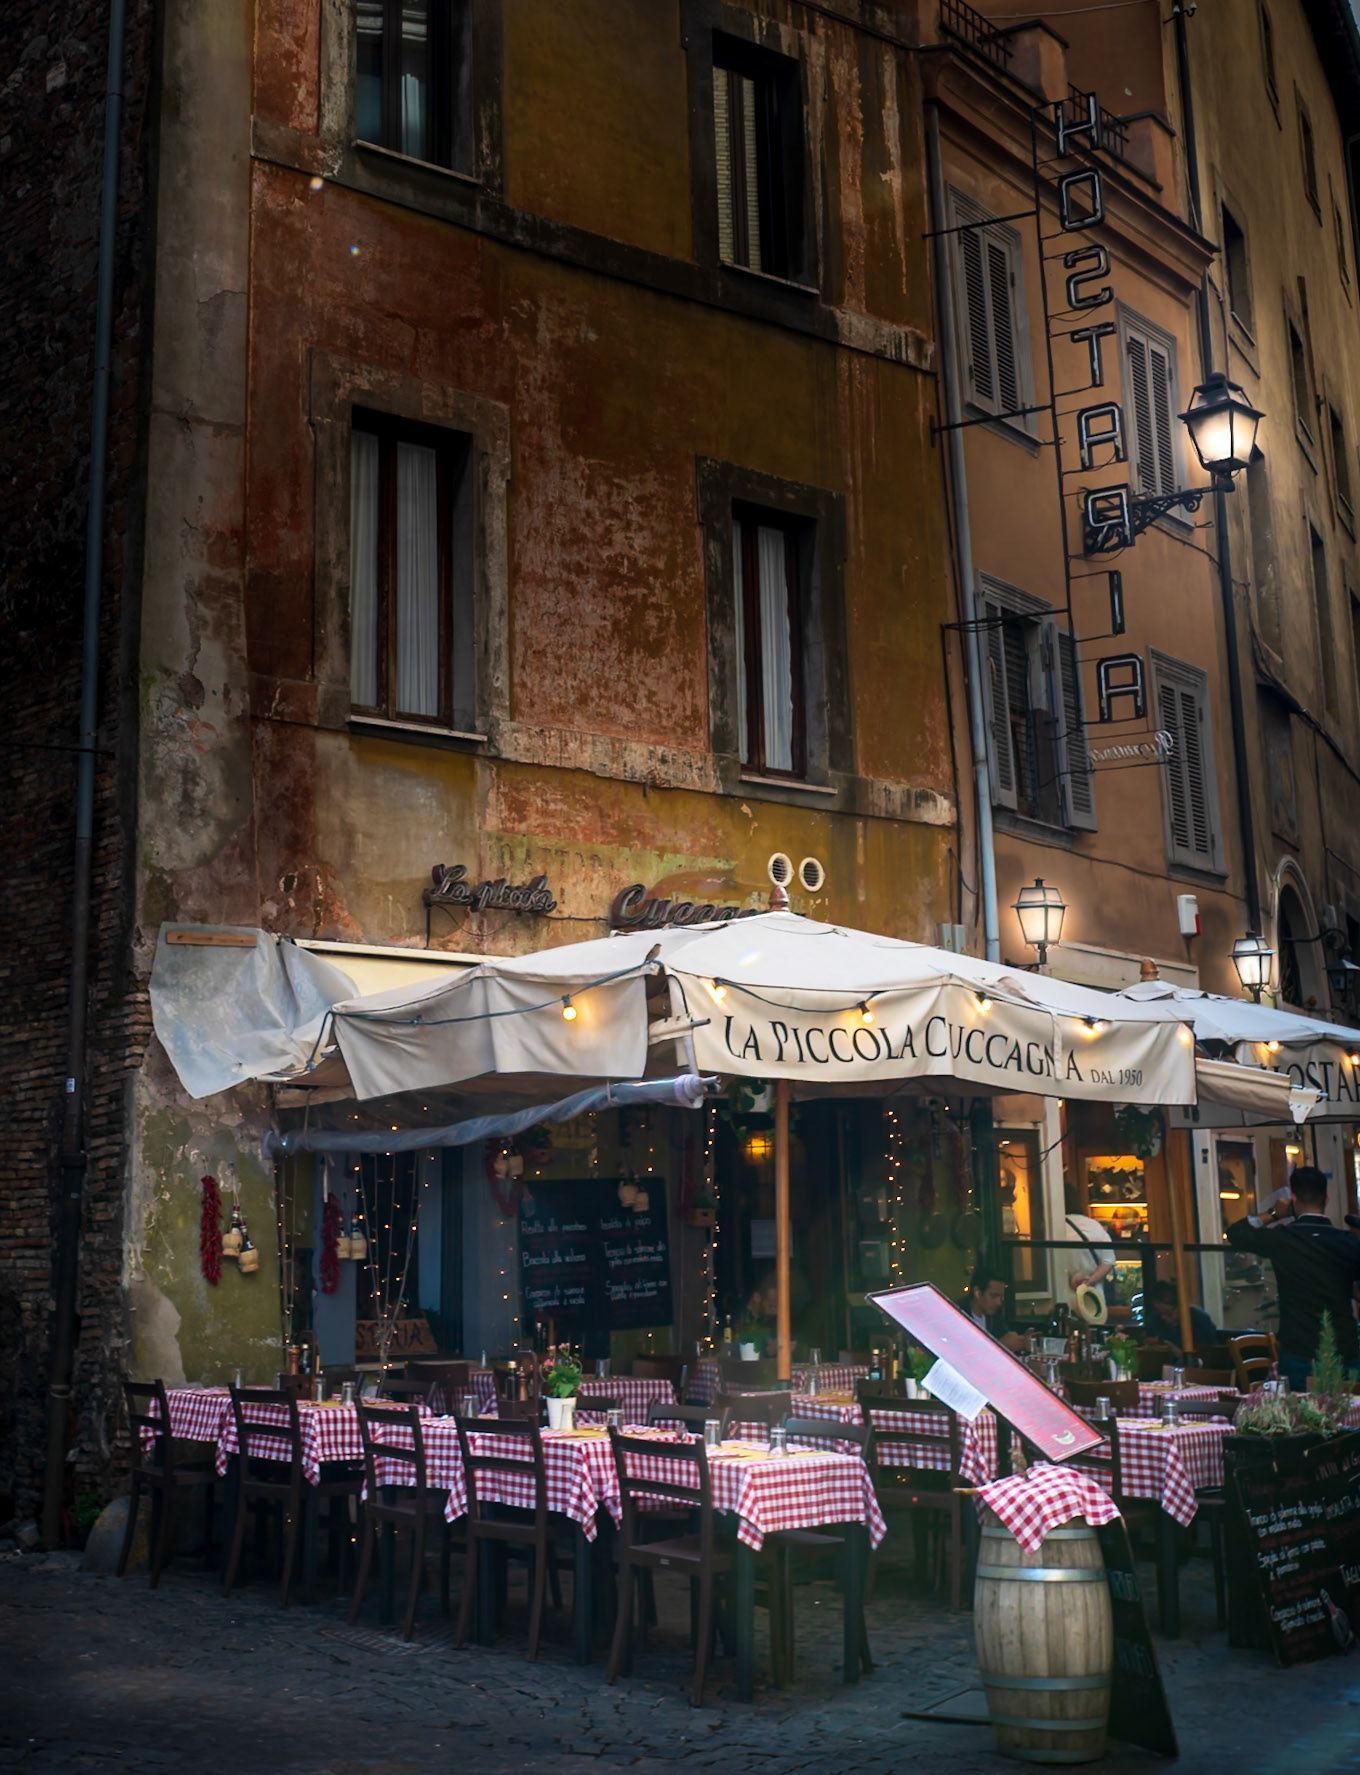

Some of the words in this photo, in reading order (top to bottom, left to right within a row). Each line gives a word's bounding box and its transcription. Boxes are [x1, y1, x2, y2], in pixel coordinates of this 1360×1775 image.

[432, 864, 472, 902] La
[724, 1015, 763, 1061] LA
[768, 1020, 918, 1064] PICCOLA
[1091, 1069, 1116, 1085] DAL
[1118, 1069, 1143, 1087] 1950
